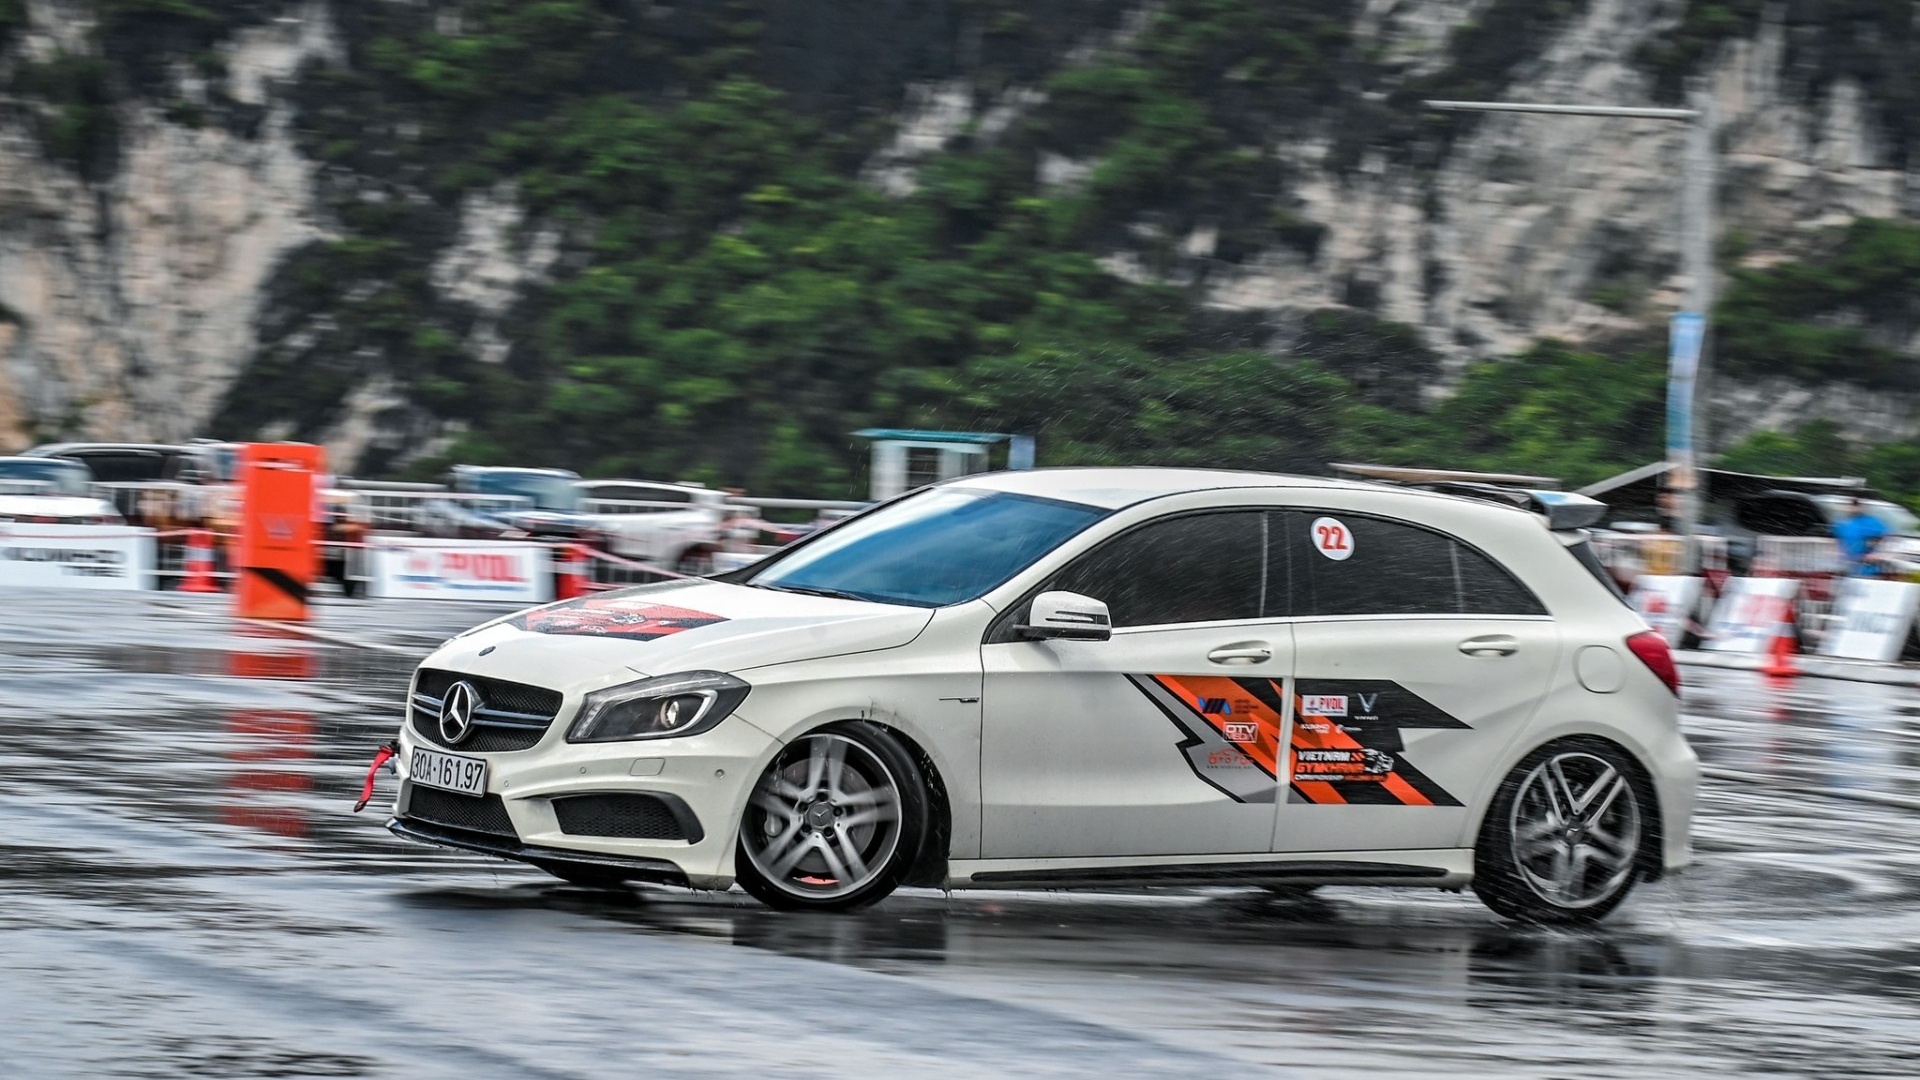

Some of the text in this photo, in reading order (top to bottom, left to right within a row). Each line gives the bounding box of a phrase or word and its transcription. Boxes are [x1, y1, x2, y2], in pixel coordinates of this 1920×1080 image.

[1317, 525, 1348, 550] 22
[1320, 697, 1344, 710] PVOIL
[1298, 751, 1351, 761] VIETNAM
[412, 752, 483, 791] 30A-161.97
